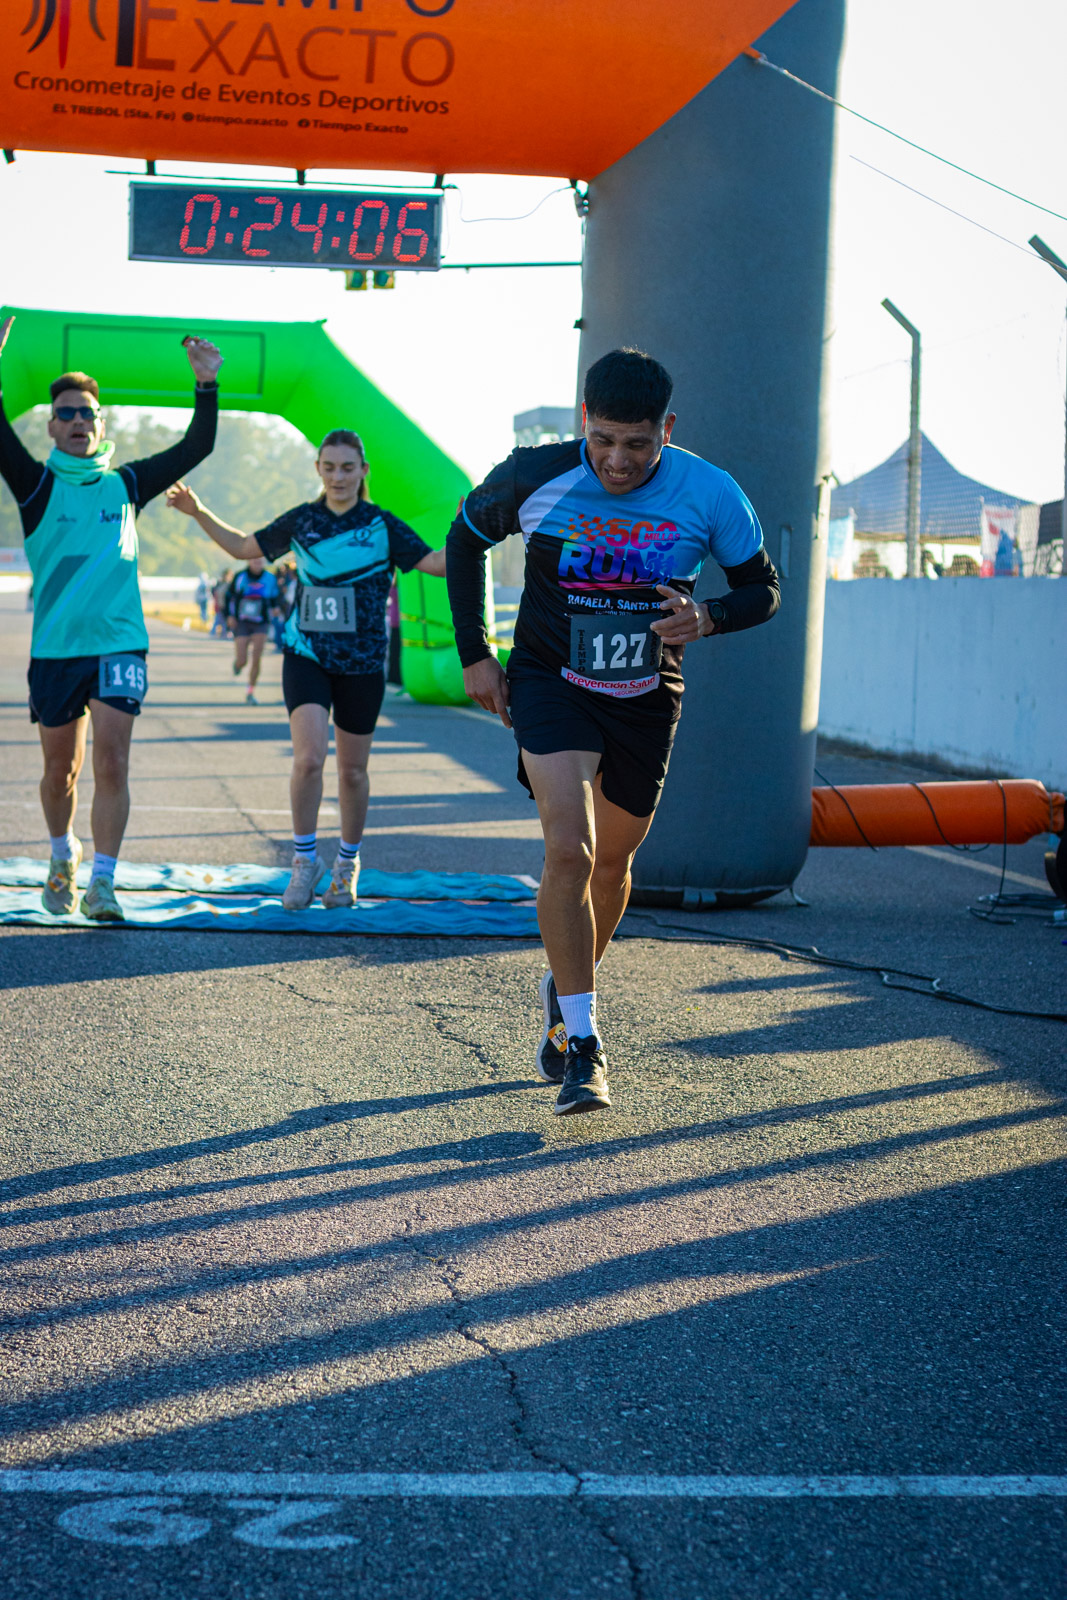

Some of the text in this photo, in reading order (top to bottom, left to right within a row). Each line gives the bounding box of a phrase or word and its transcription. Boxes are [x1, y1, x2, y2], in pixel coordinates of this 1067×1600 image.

[136, 0, 455, 87] EXACTO
[13, 70, 449, 115] Cronometraje de Eventos Deportivos
[53, 103, 67, 114] EL
[70, 104, 121, 117] TREBOL
[156, 110, 175, 121] Fe)
[312, 119, 409, 134] Tiempo Exacto
[179, 194, 429, 262] 0:24:06
[605, 518, 677, 552] 500
[643, 532, 681, 542] MILLAS
[558, 541, 659, 583] RUN
[315, 596, 338, 621] 13
[567, 594, 614, 609] RAFAELA,
[617, 598, 649, 611] SANTA
[592, 632, 647, 670] 127
[112, 663, 145, 692] 145
[566, 672, 627, 689] Prevención
